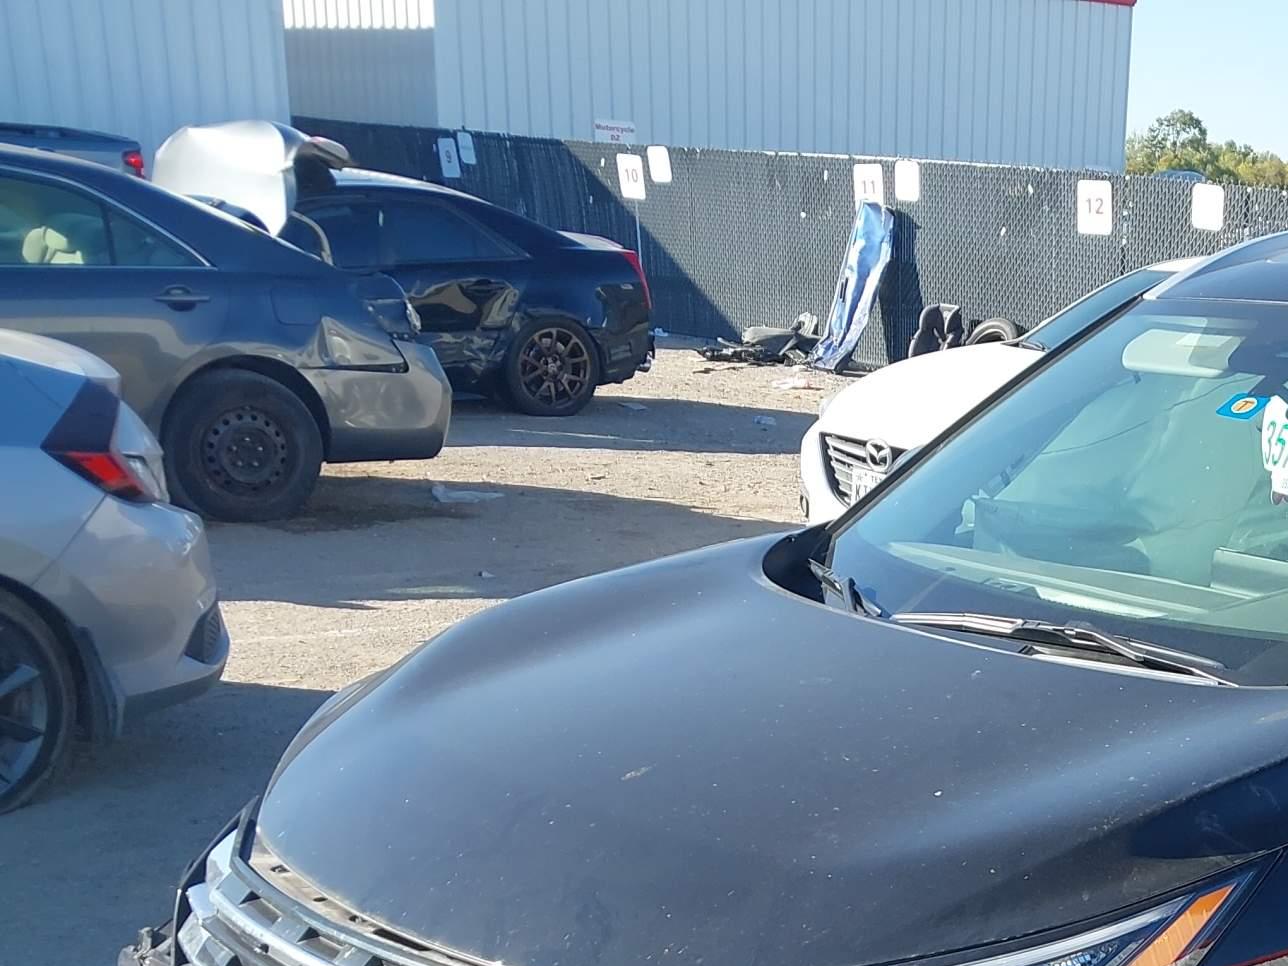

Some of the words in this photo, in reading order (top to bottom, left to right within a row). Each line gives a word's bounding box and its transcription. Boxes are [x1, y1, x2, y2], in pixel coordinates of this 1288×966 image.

[594, 123, 635, 134] Motorcycle
[625, 168, 638, 183] 10
[862, 180, 875, 194] 11
[1085, 198, 1104, 215] 12
